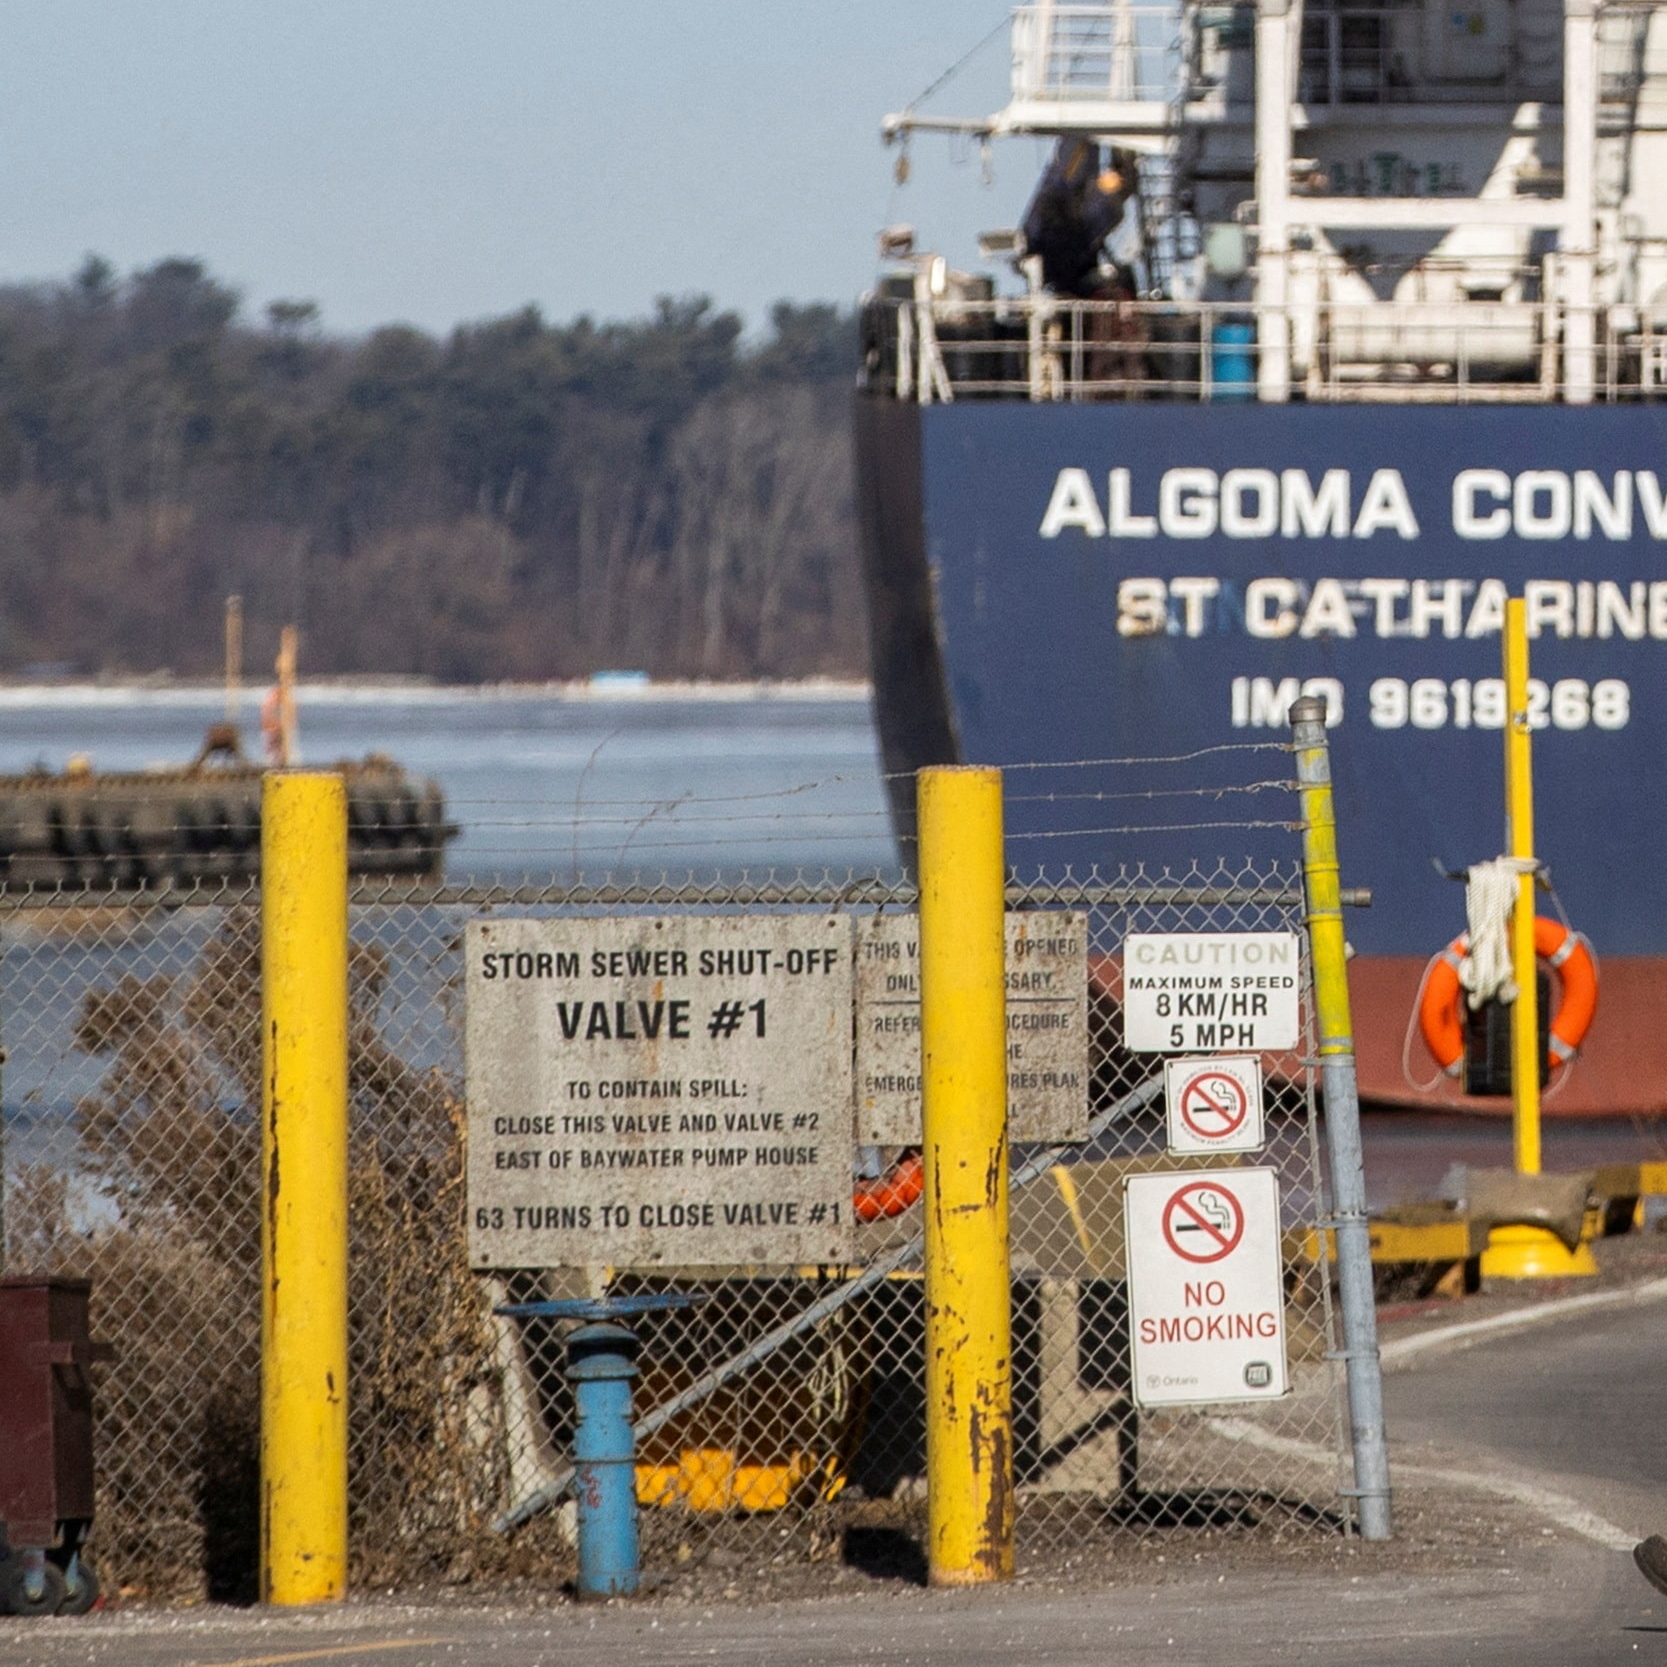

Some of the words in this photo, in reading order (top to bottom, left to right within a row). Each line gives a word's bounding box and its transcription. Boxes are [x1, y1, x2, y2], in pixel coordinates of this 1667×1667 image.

[1039, 467, 1419, 540] ALGOMA
[1117, 577, 1219, 638] ST
[1231, 676, 1345, 729] IMO
[1369, 678, 1631, 730] 9619268
[865, 941, 900, 960] THIS
[1136, 941, 1290, 966] CAUTION
[482, 952, 580, 980] STORM
[591, 950, 688, 978] SEWER
[699, 947, 838, 976] SHUT-OFF
[886, 975, 918, 993] ONL
[1003, 971, 1057, 991] SSARY.
[1129, 975, 1223, 990] MAXIMUM
[1230, 974, 1294, 990] SPEED
[1156, 994, 1171, 1018] 8
[1178, 992, 1268, 1018] KM/HR
[557, 999, 691, 1040] VALVE
[707, 998, 768, 1039] #1
[1170, 1024, 1185, 1048] 5
[1196, 1023, 1256, 1048] MPH
[1006, 1043, 1022, 1060] HE
[568, 1081, 590, 1100] TO
[598, 1080, 682, 1099] CONTAIN
[689, 1079, 748, 1098] SPILL:
[864, 1076, 922, 1093] EMERGE
[494, 1115, 555, 1135] CLOSE
[561, 1115, 606, 1134] THIS
[611, 1114, 672, 1133] VALVE
[679, 1114, 718, 1132] AND
[724, 1113, 785, 1132] VALVE
[792, 1112, 820, 1130] #2
[494, 1150, 541, 1170] EAST
[548, 1150, 573, 1169] OF
[580, 1148, 685, 1169] BAYWATER
[691, 1147, 749, 1167] PUMP
[755, 1146, 819, 1166] HOUSE
[476, 1208, 505, 1230] 63
[513, 1207, 592, 1229] TURNS
[600, 1205, 630, 1228] TO
[639, 1205, 715, 1227] CLOSE
[724, 1203, 799, 1226] VALVE
[807, 1202, 841, 1225] #1
[1184, 1281, 1226, 1307] NO
[1140, 1312, 1277, 1344] SMOKING
